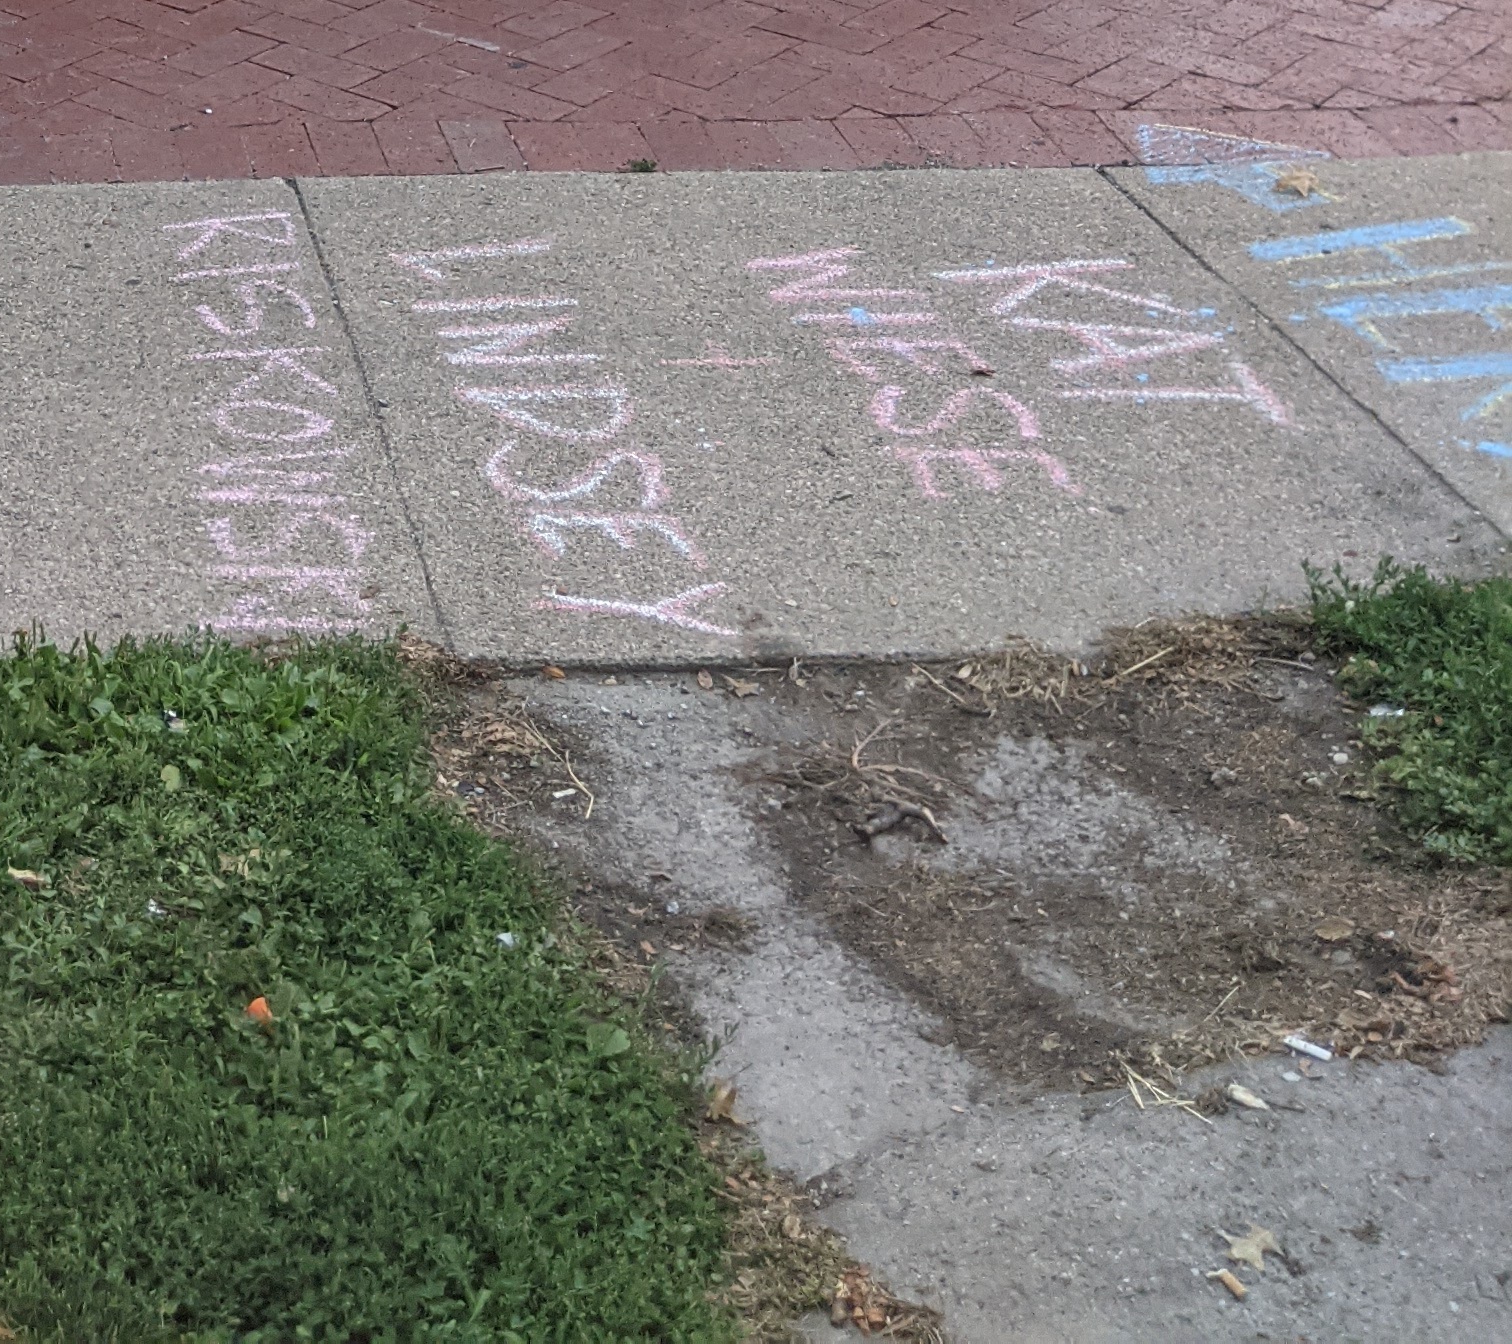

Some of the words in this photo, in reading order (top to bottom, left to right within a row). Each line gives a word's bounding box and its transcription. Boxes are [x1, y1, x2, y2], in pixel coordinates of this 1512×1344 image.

[388, 237, 740, 636] LINDSEY
[744, 243, 1083, 499] NIESE
[930, 256, 1296, 428] KAT
